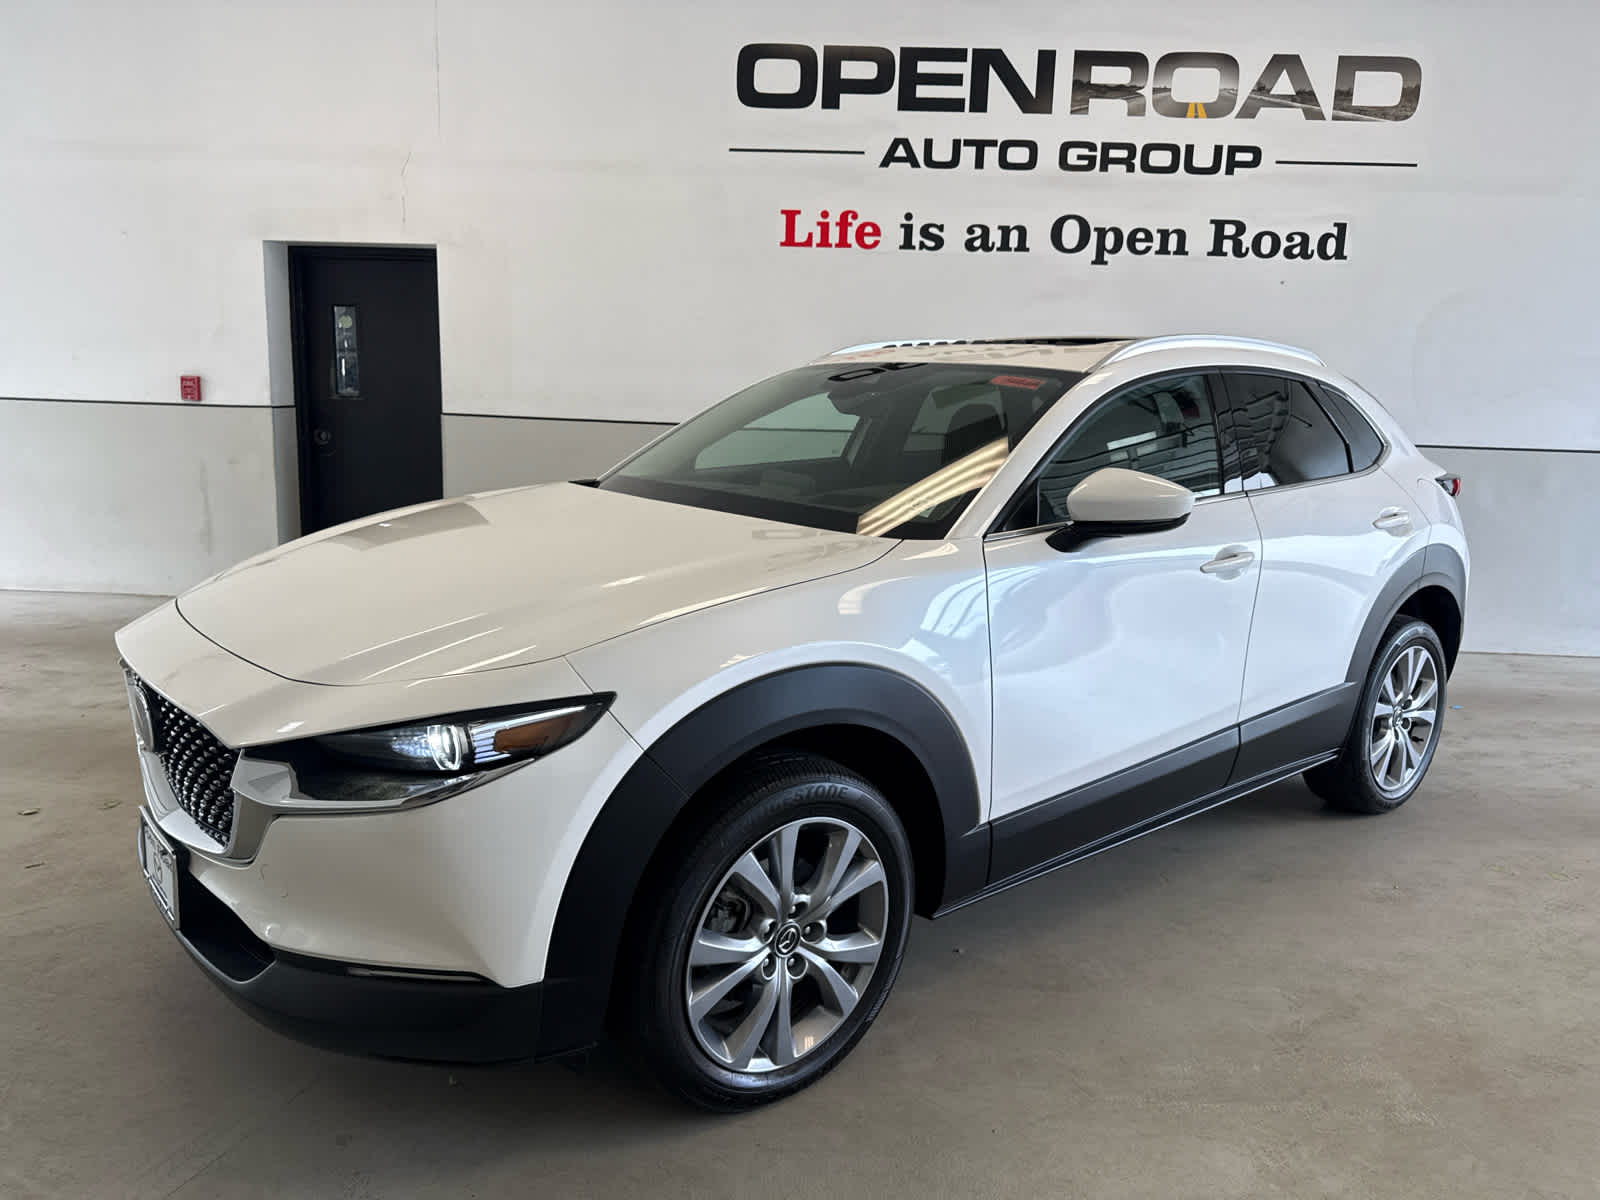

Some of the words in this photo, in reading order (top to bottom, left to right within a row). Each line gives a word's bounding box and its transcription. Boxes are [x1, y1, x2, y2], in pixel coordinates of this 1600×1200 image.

[736, 42, 1057, 115] OPEN
[1069, 49, 1422, 122] ROAD
[878, 137, 1039, 171] AUTO
[1058, 140, 1263, 176] GROUP
[779, 209, 882, 250] Life
[898, 211, 945, 252] is
[964, 223, 1030, 253] an
[1050, 214, 1189, 266] Open
[1206, 218, 1348, 261] Road
